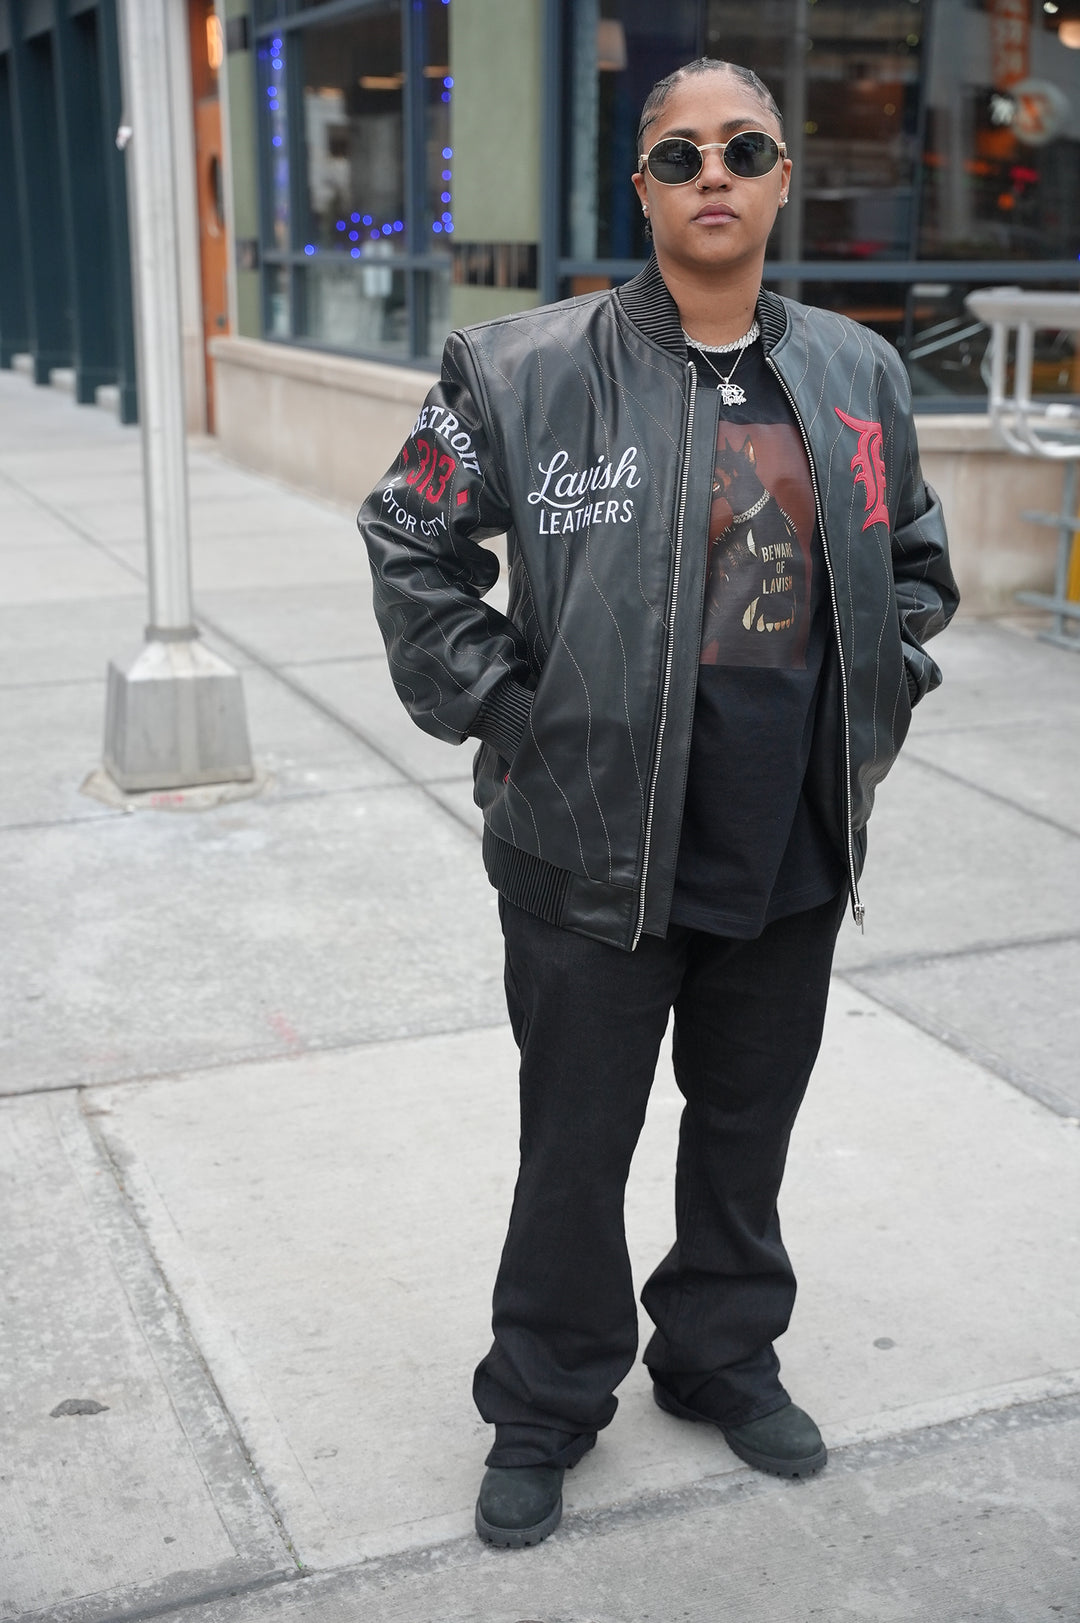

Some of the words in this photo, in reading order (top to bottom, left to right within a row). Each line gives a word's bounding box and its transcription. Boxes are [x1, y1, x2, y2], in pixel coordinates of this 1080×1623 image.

[411, 405, 481, 475] DETROIT
[406, 438, 456, 504] 313
[527, 446, 641, 509] Lavish
[420, 512, 448, 537] CITY
[538, 499, 634, 535] LEATHERS
[761, 542, 793, 563] BEWARE
[776, 560, 785, 574] OF
[762, 575, 793, 595] LAVISH
